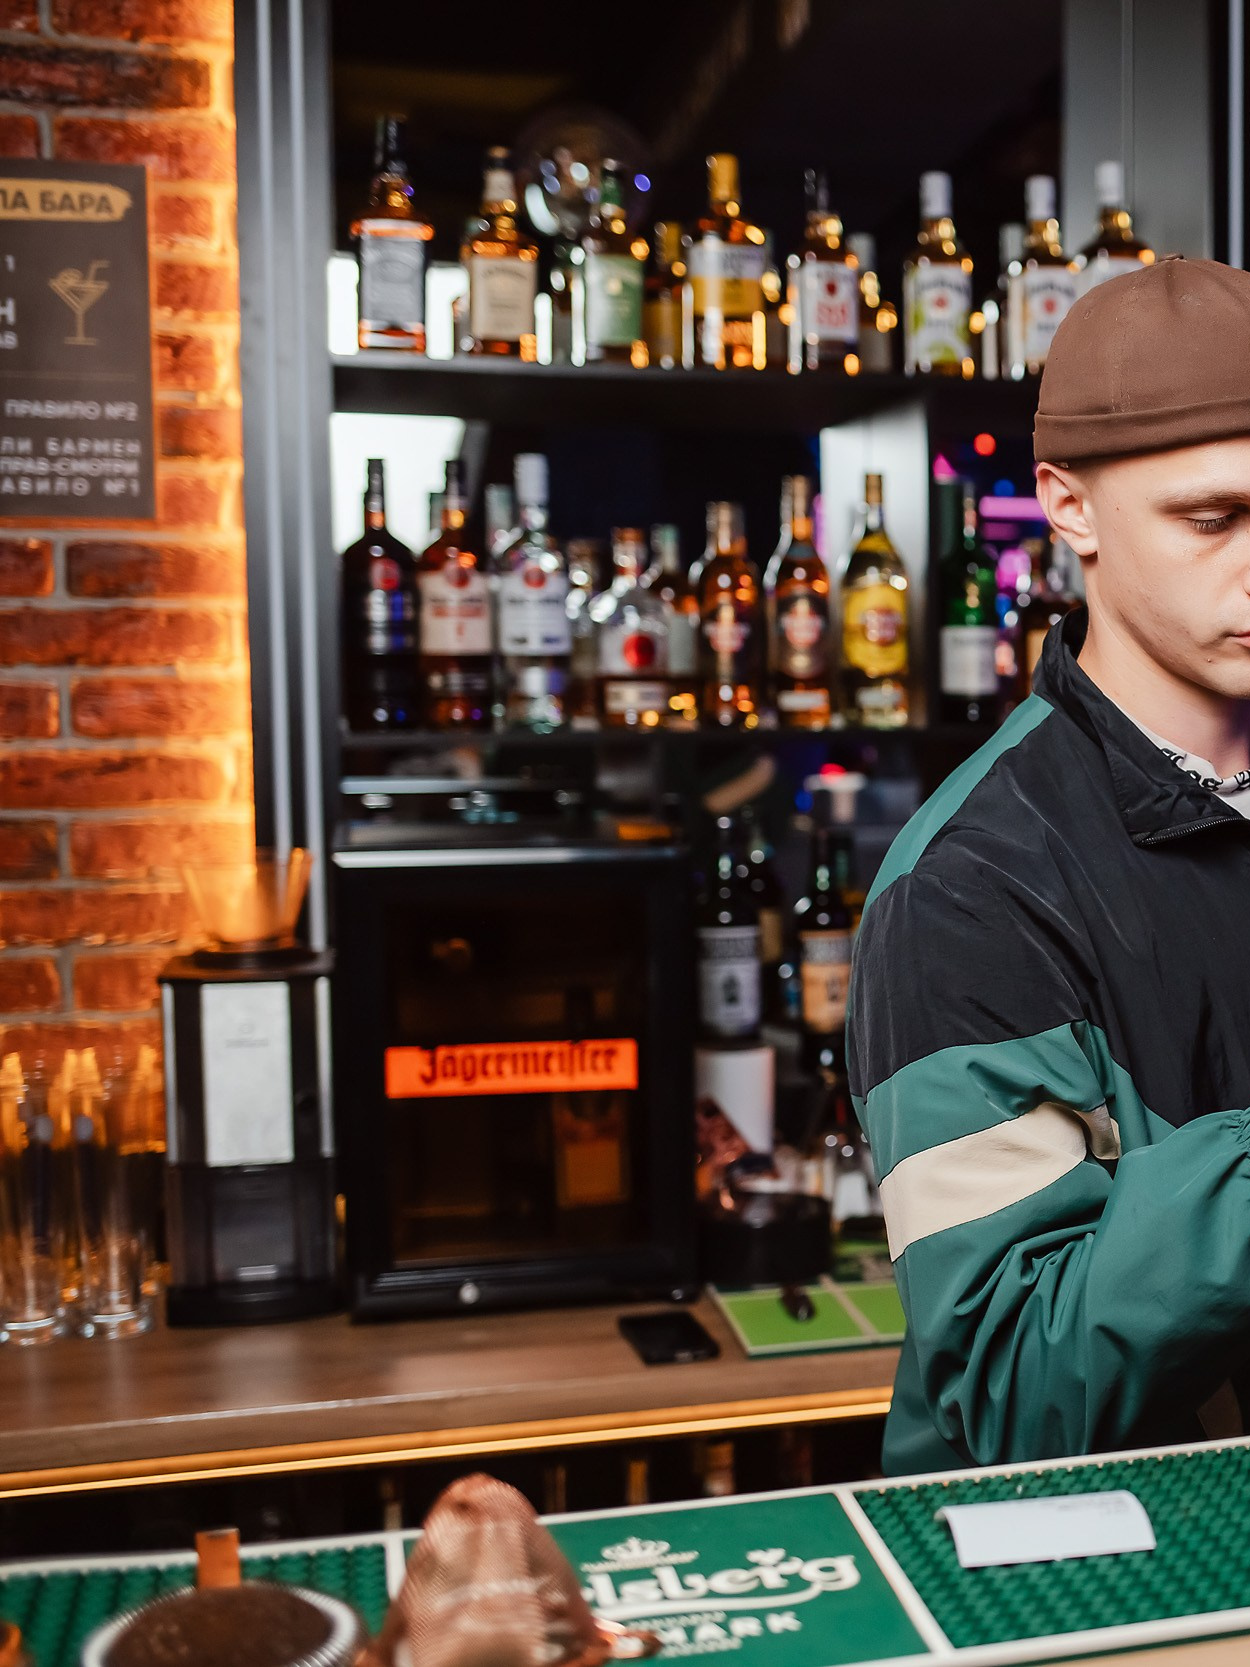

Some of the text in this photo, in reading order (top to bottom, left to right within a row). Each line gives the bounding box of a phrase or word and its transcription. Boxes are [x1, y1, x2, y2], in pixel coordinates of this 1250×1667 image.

[40, 190, 113, 213] БАРА
[5, 399, 101, 420] ПРАВИЛО
[46, 437, 140, 457] БАРМЕН
